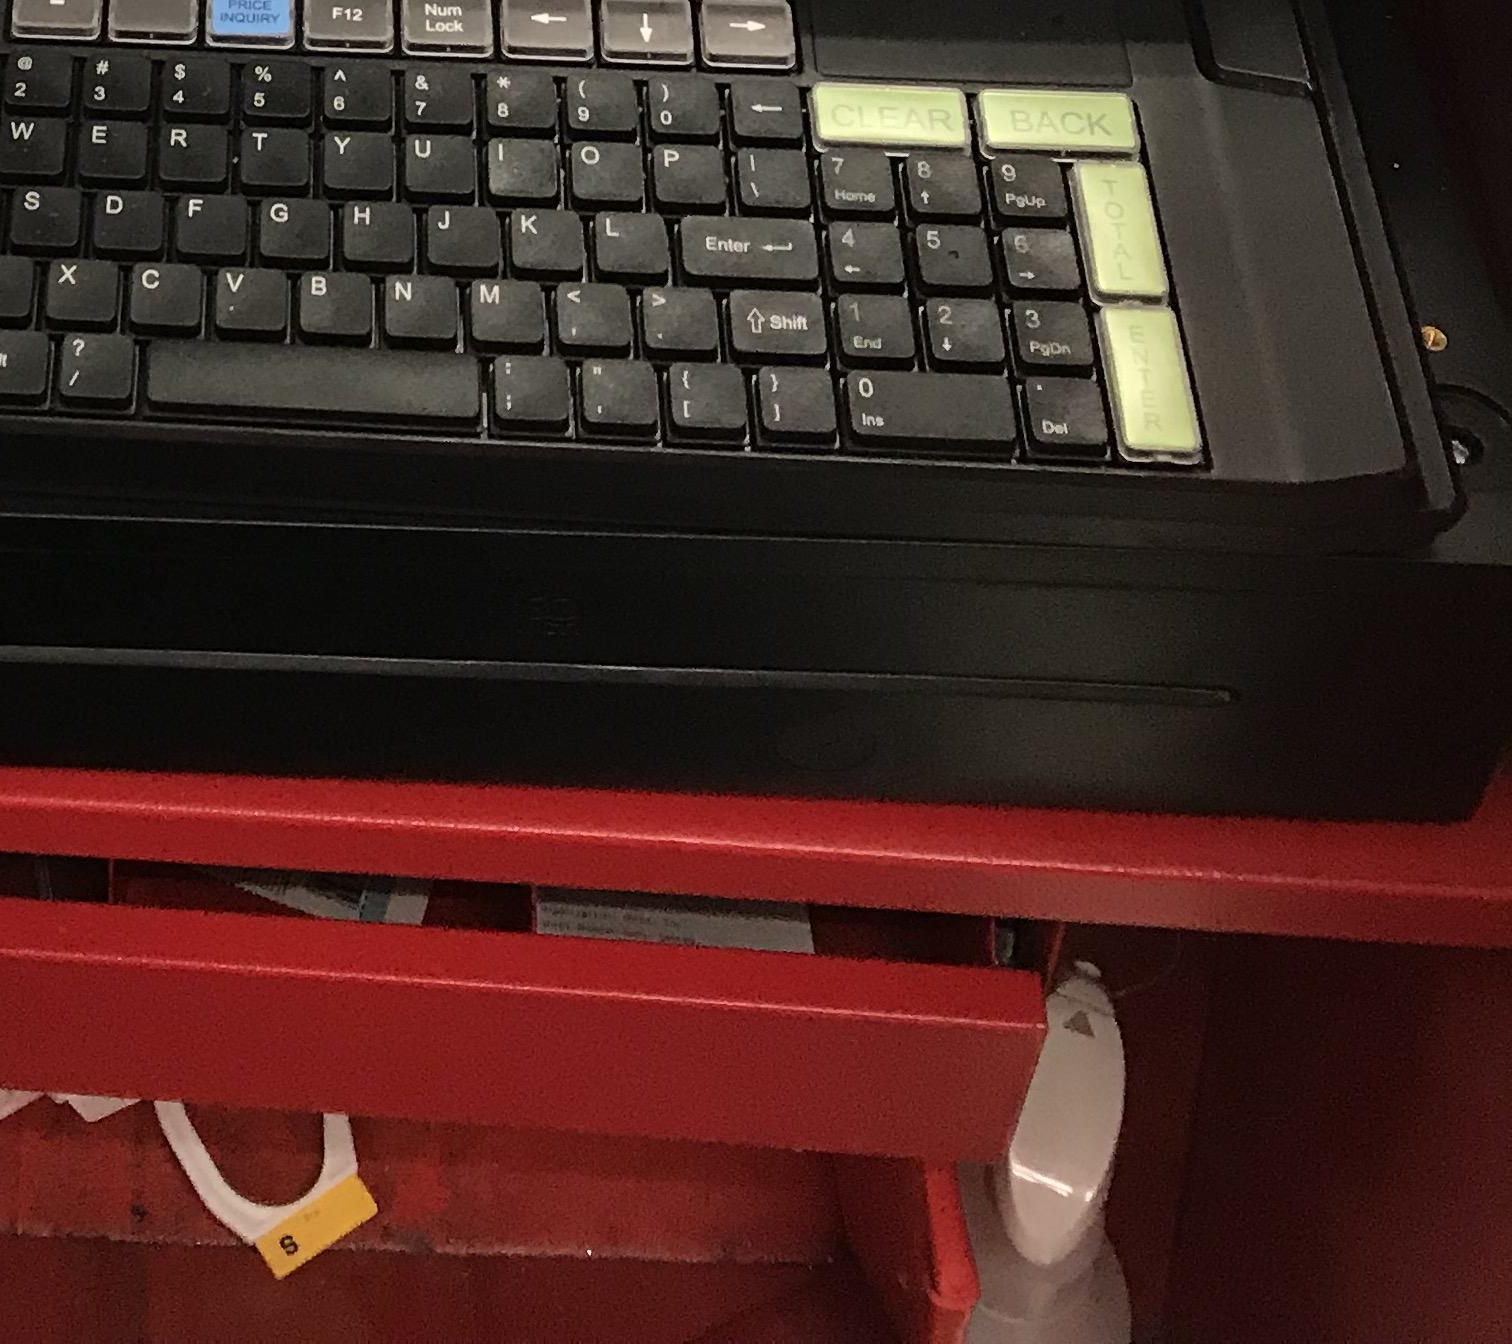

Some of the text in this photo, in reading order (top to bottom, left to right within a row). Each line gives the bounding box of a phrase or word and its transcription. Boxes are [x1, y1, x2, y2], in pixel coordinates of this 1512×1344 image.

[227, 0, 273, 12] PRICE
[332, 6, 363, 22] F12
[424, 3, 463, 17] Num
[219, 12, 281, 26] INQUIRY
[425, 19, 464, 33] Lock
[14, 82, 27, 97] 2
[93, 85, 106, 101] 3
[172, 89, 185, 104] 4
[253, 92, 266, 107] 5
[333, 95, 345, 111] 6
[415, 100, 427, 116] 7
[497, 102, 509, 118] 8
[577, 106, 590, 122] 9
[659, 109, 673, 125] 0
[10, 121, 35, 140] W
[1010, 108, 1113, 138] BACK
[91, 125, 108, 144] E
[170, 128, 187, 148] R
[252, 132, 268, 151] T
[333, 136, 351, 155] Y
[414, 139, 431, 158] U
[663, 149, 680, 168] P
[23, 191, 41, 211] S
[105, 195, 124, 214] D
[834, 189, 876, 203] Home
[1005, 192, 1046, 209] PgUp
[188, 198, 204, 218] F
[269, 203, 289, 223] G
[353, 205, 371, 225] H
[437, 210, 450, 230] J
[520, 214, 538, 235] K
[605, 217, 620, 237] L
[705, 235, 751, 253] Enter
[58, 264, 77, 285] X
[141, 269, 160, 290] C
[225, 272, 244, 293] V
[311, 276, 327, 296] B
[394, 281, 412, 301] N
[479, 284, 500, 304] M
[769, 314, 808, 330] Shift
[852, 335, 882, 349] End
[1029, 340, 1072, 357] PgDn
[861, 412, 885, 427] Ins
[1041, 419, 1069, 435] Del
[279, 1234, 299, 1257] S
